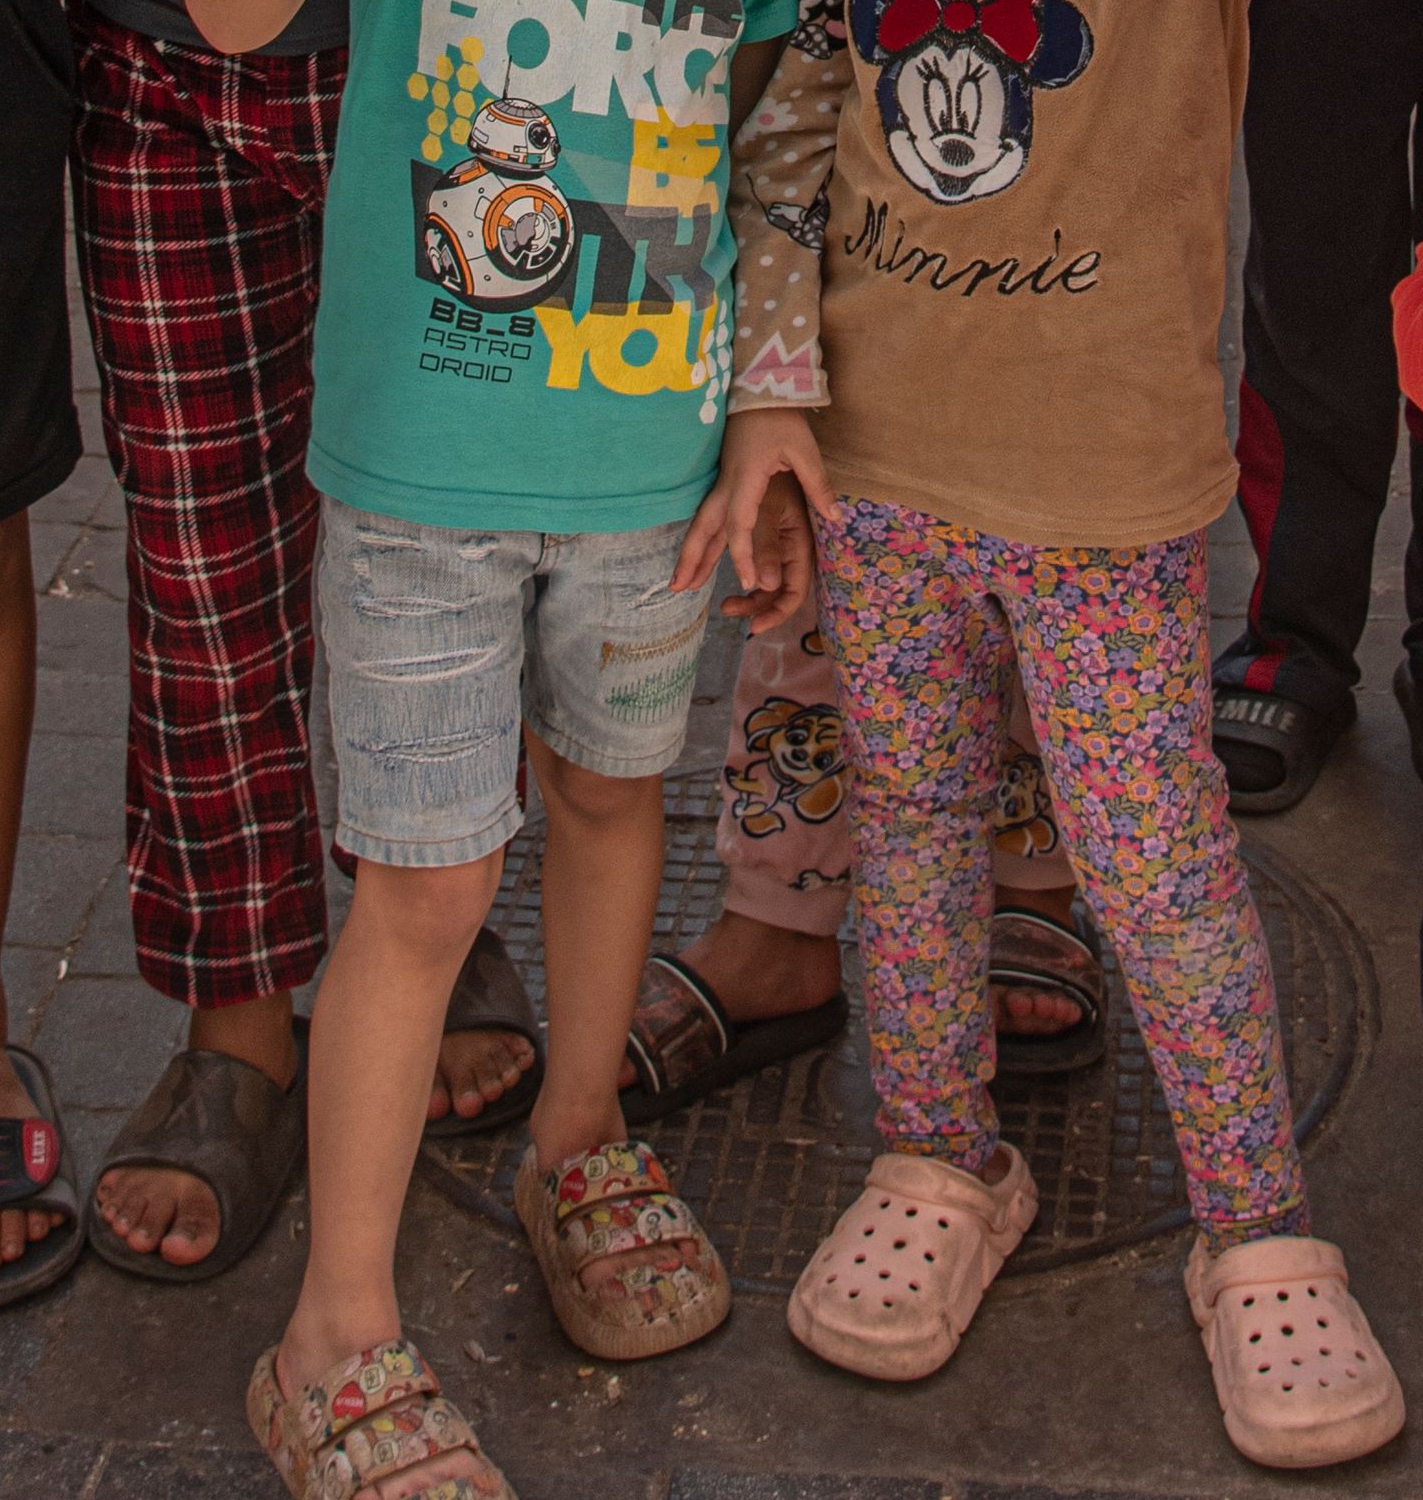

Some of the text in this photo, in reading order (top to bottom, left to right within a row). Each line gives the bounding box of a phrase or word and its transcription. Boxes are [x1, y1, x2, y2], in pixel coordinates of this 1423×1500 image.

[844, 196, 1102, 297] Minnie
[424, 327, 532, 360] ASTRO
[419, 353, 513, 384] DROID
[1214, 699, 1296, 731] MILE
